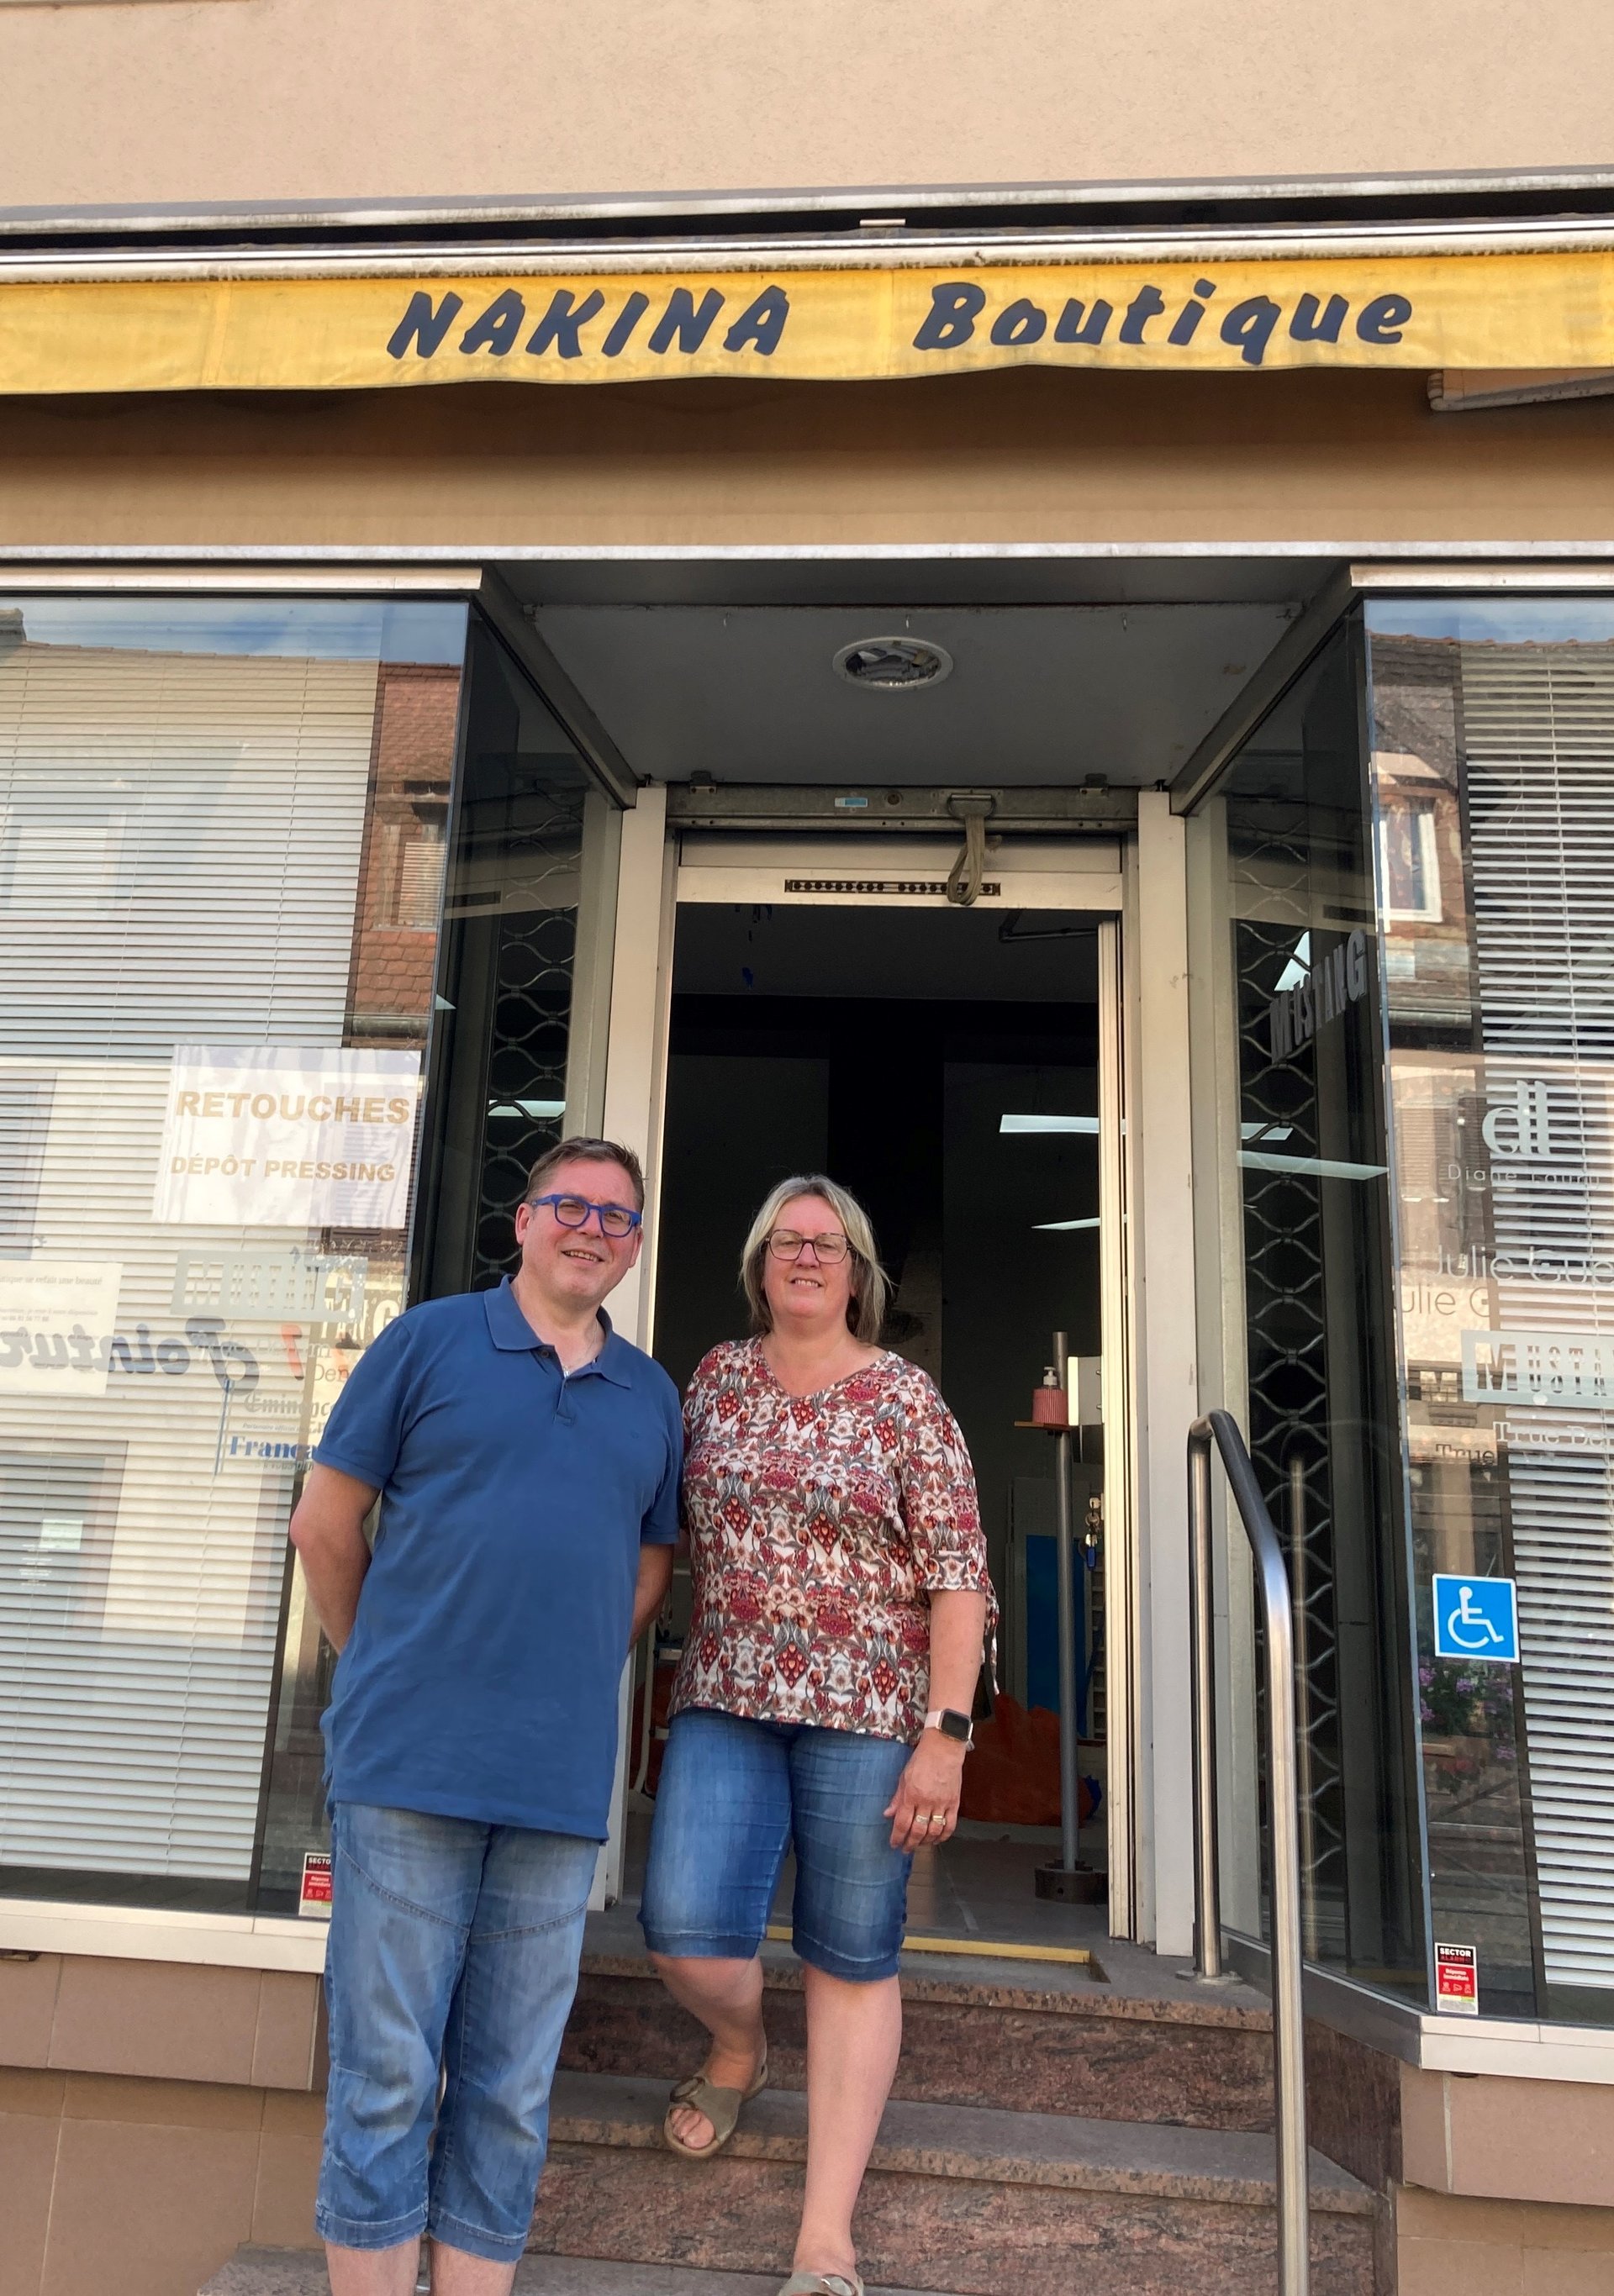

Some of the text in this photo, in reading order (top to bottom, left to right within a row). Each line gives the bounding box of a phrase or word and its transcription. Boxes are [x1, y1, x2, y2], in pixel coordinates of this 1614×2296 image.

[386, 278, 1412, 366] NAKINA Boutique
[176, 1091, 410, 1124] RETOUCHES
[171, 1152, 396, 1182] DÉPÔT PRESSING
[1448, 1164, 1517, 1183] Diane
[1427, 1245, 1514, 1281] Julie
[1475, 1343, 1614, 1397] MUSTA
[1493, 1420, 1559, 1444] True
[1435, 1443, 1495, 1465] True
[309, 1856, 332, 1865] SECTO
[1439, 1947, 1472, 1957] SECTOR
